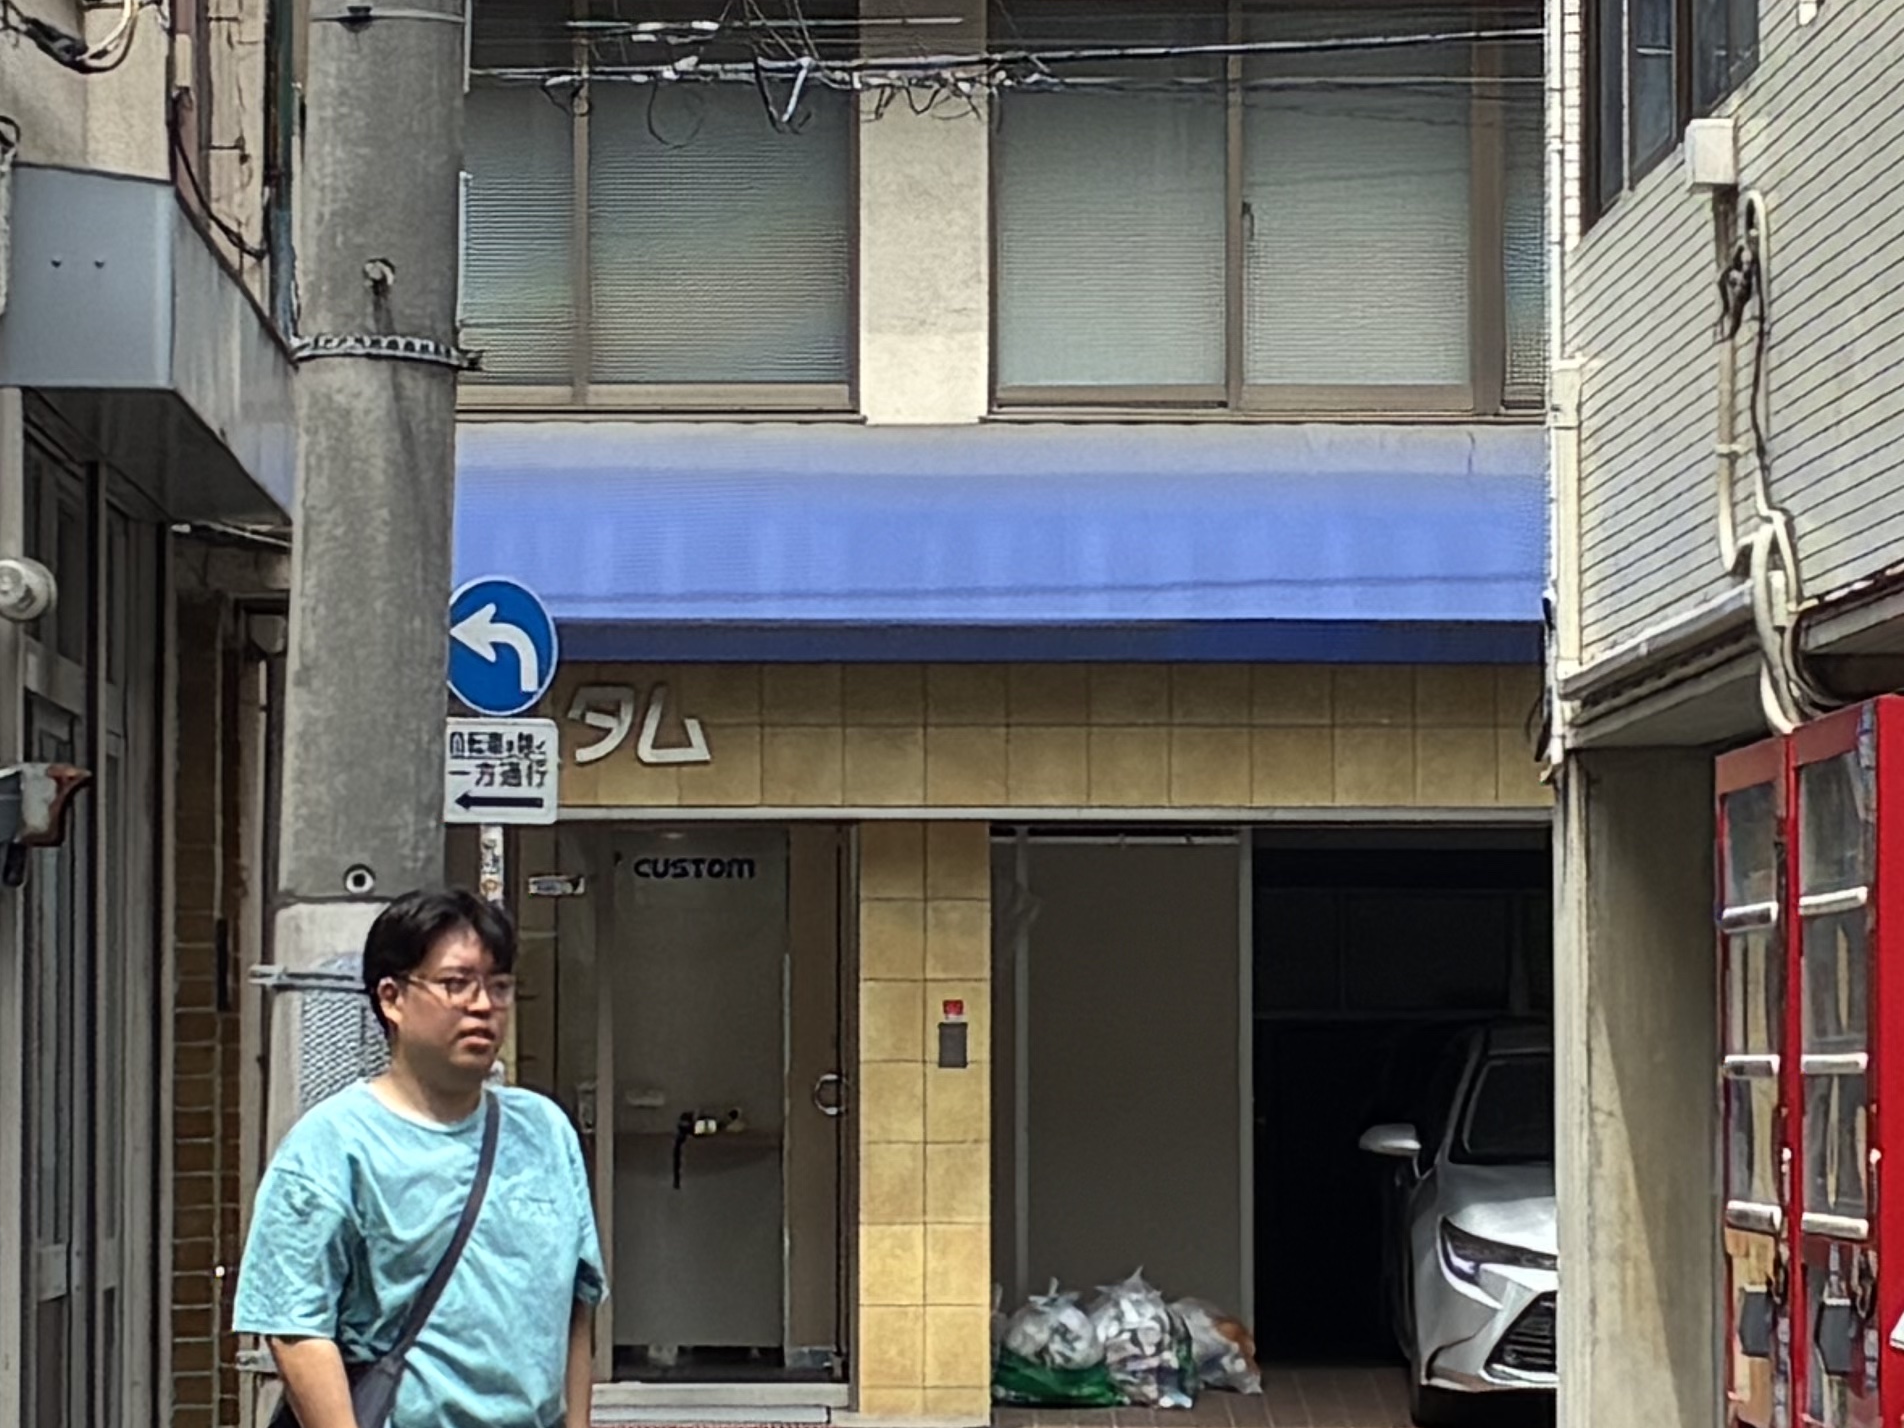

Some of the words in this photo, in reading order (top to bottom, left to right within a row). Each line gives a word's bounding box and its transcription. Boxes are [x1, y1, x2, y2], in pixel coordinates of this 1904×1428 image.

[567, 684, 712, 764] タム
[447, 761, 547, 788] 一方通行
